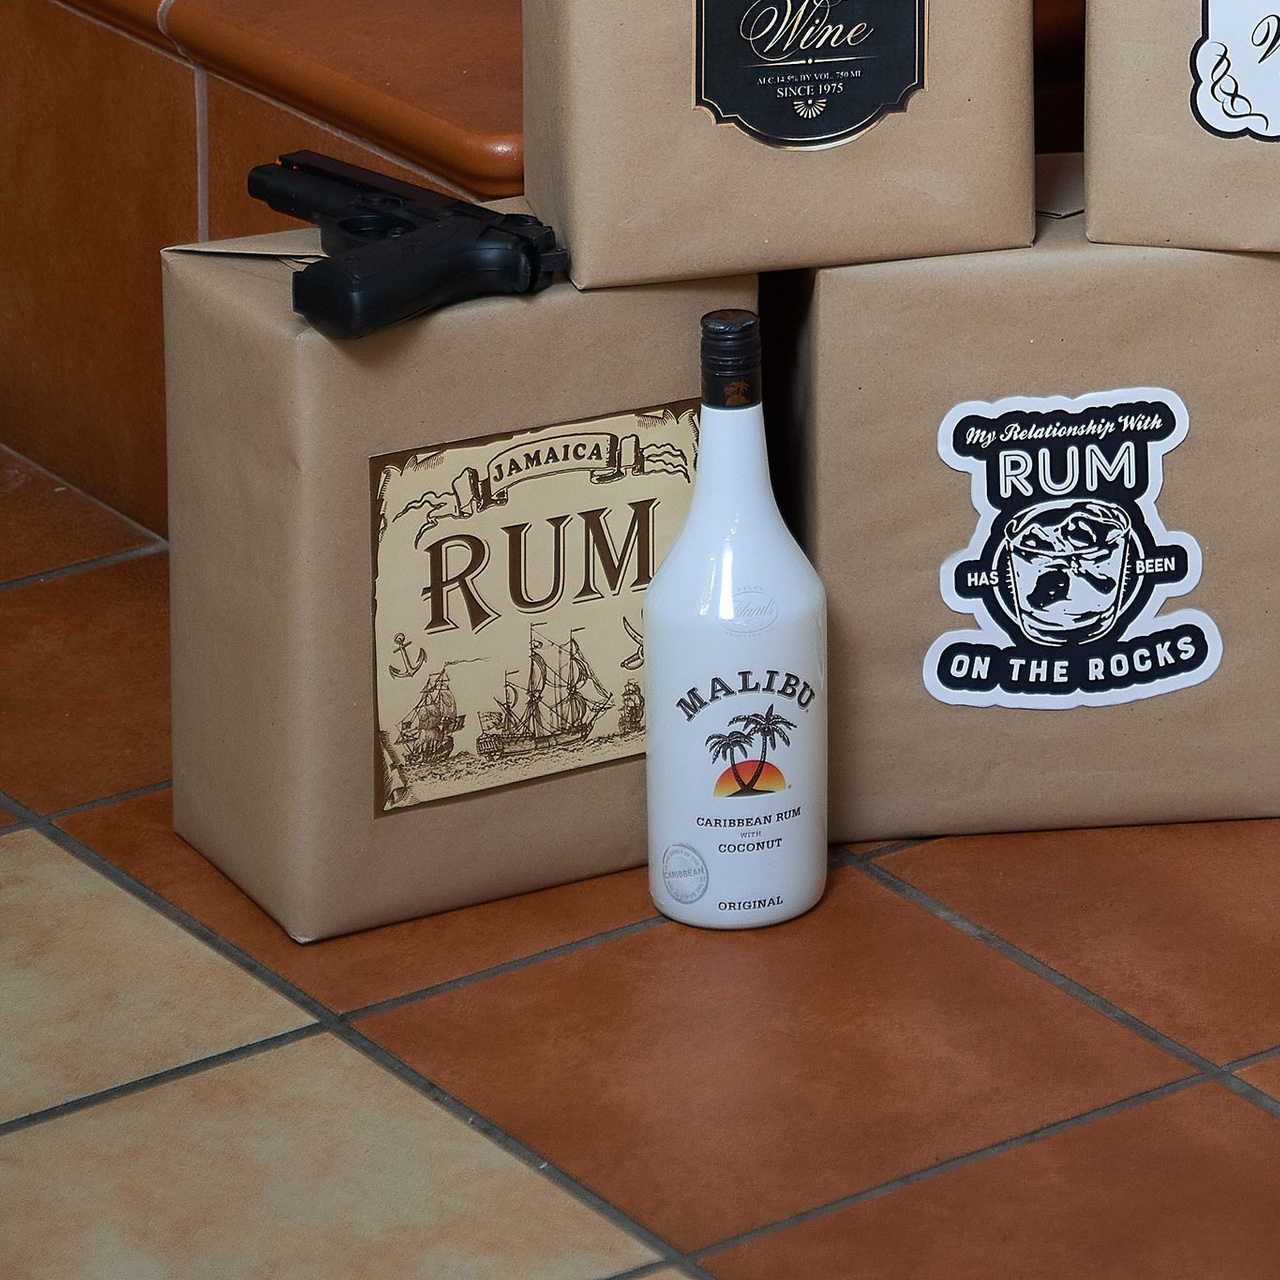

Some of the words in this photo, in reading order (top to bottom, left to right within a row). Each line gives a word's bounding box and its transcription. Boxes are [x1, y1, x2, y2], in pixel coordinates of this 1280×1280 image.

[777, 85, 814, 98] SINCE
[819, 83, 843, 94] 1975
[966, 427, 997, 448] My
[1000, 419, 1115, 441] Relationship
[1118, 414, 1163, 432] With
[493, 443, 603, 482] JAMAICA
[999, 441, 1135, 498] RUM
[421, 498, 661, 634] RUM
[967, 571, 999, 587] HAS
[1136, 557, 1176, 574] BEEN
[950, 655, 990, 680] ON
[1009, 659, 1069, 683] THE
[1088, 637, 1196, 681] ROCKS
[676, 670, 816, 722] MALIBU
[696, 814, 772, 828] CARIBBEAN
[776, 806, 802, 822] RUM
[718, 838, 783, 853] COCONUT
[740, 831, 762, 839] WITH
[718, 896, 784, 911] ORIGINAL
